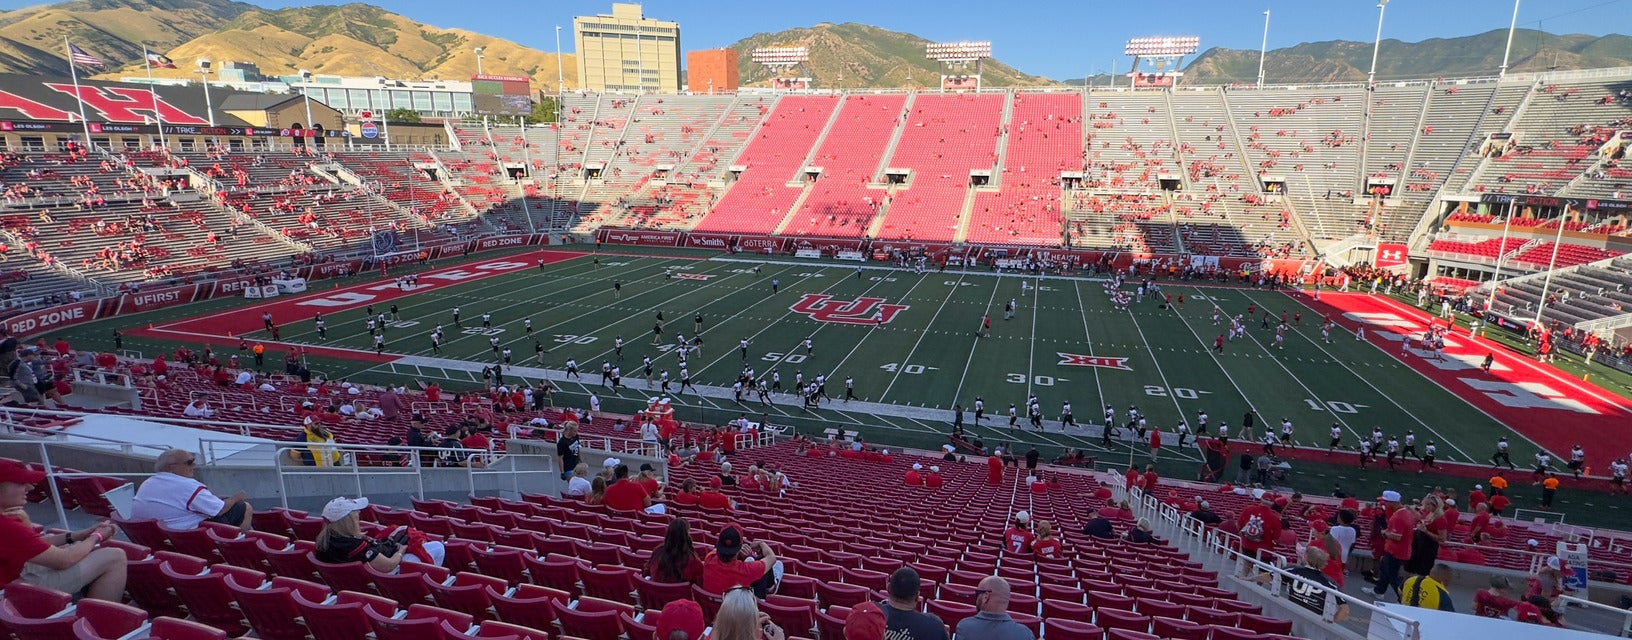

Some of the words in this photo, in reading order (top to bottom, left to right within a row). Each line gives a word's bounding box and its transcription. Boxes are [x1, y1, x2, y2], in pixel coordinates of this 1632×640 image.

[498, 237, 522, 246] ZONE
[443, 244, 464, 253] UFIRST
[222, 280, 250, 293] RED
[134, 290, 181, 306] UFIRST
[11, 318, 36, 333] RED
[38, 307, 84, 327] ZONE
[761, 352, 807, 364] 50
[880, 362, 925, 375] 40
[1006, 373, 1054, 386] 30
[1143, 385, 1198, 399] 20
[1303, 398, 1359, 414] 10
[1013, 541, 1022, 553] 7
